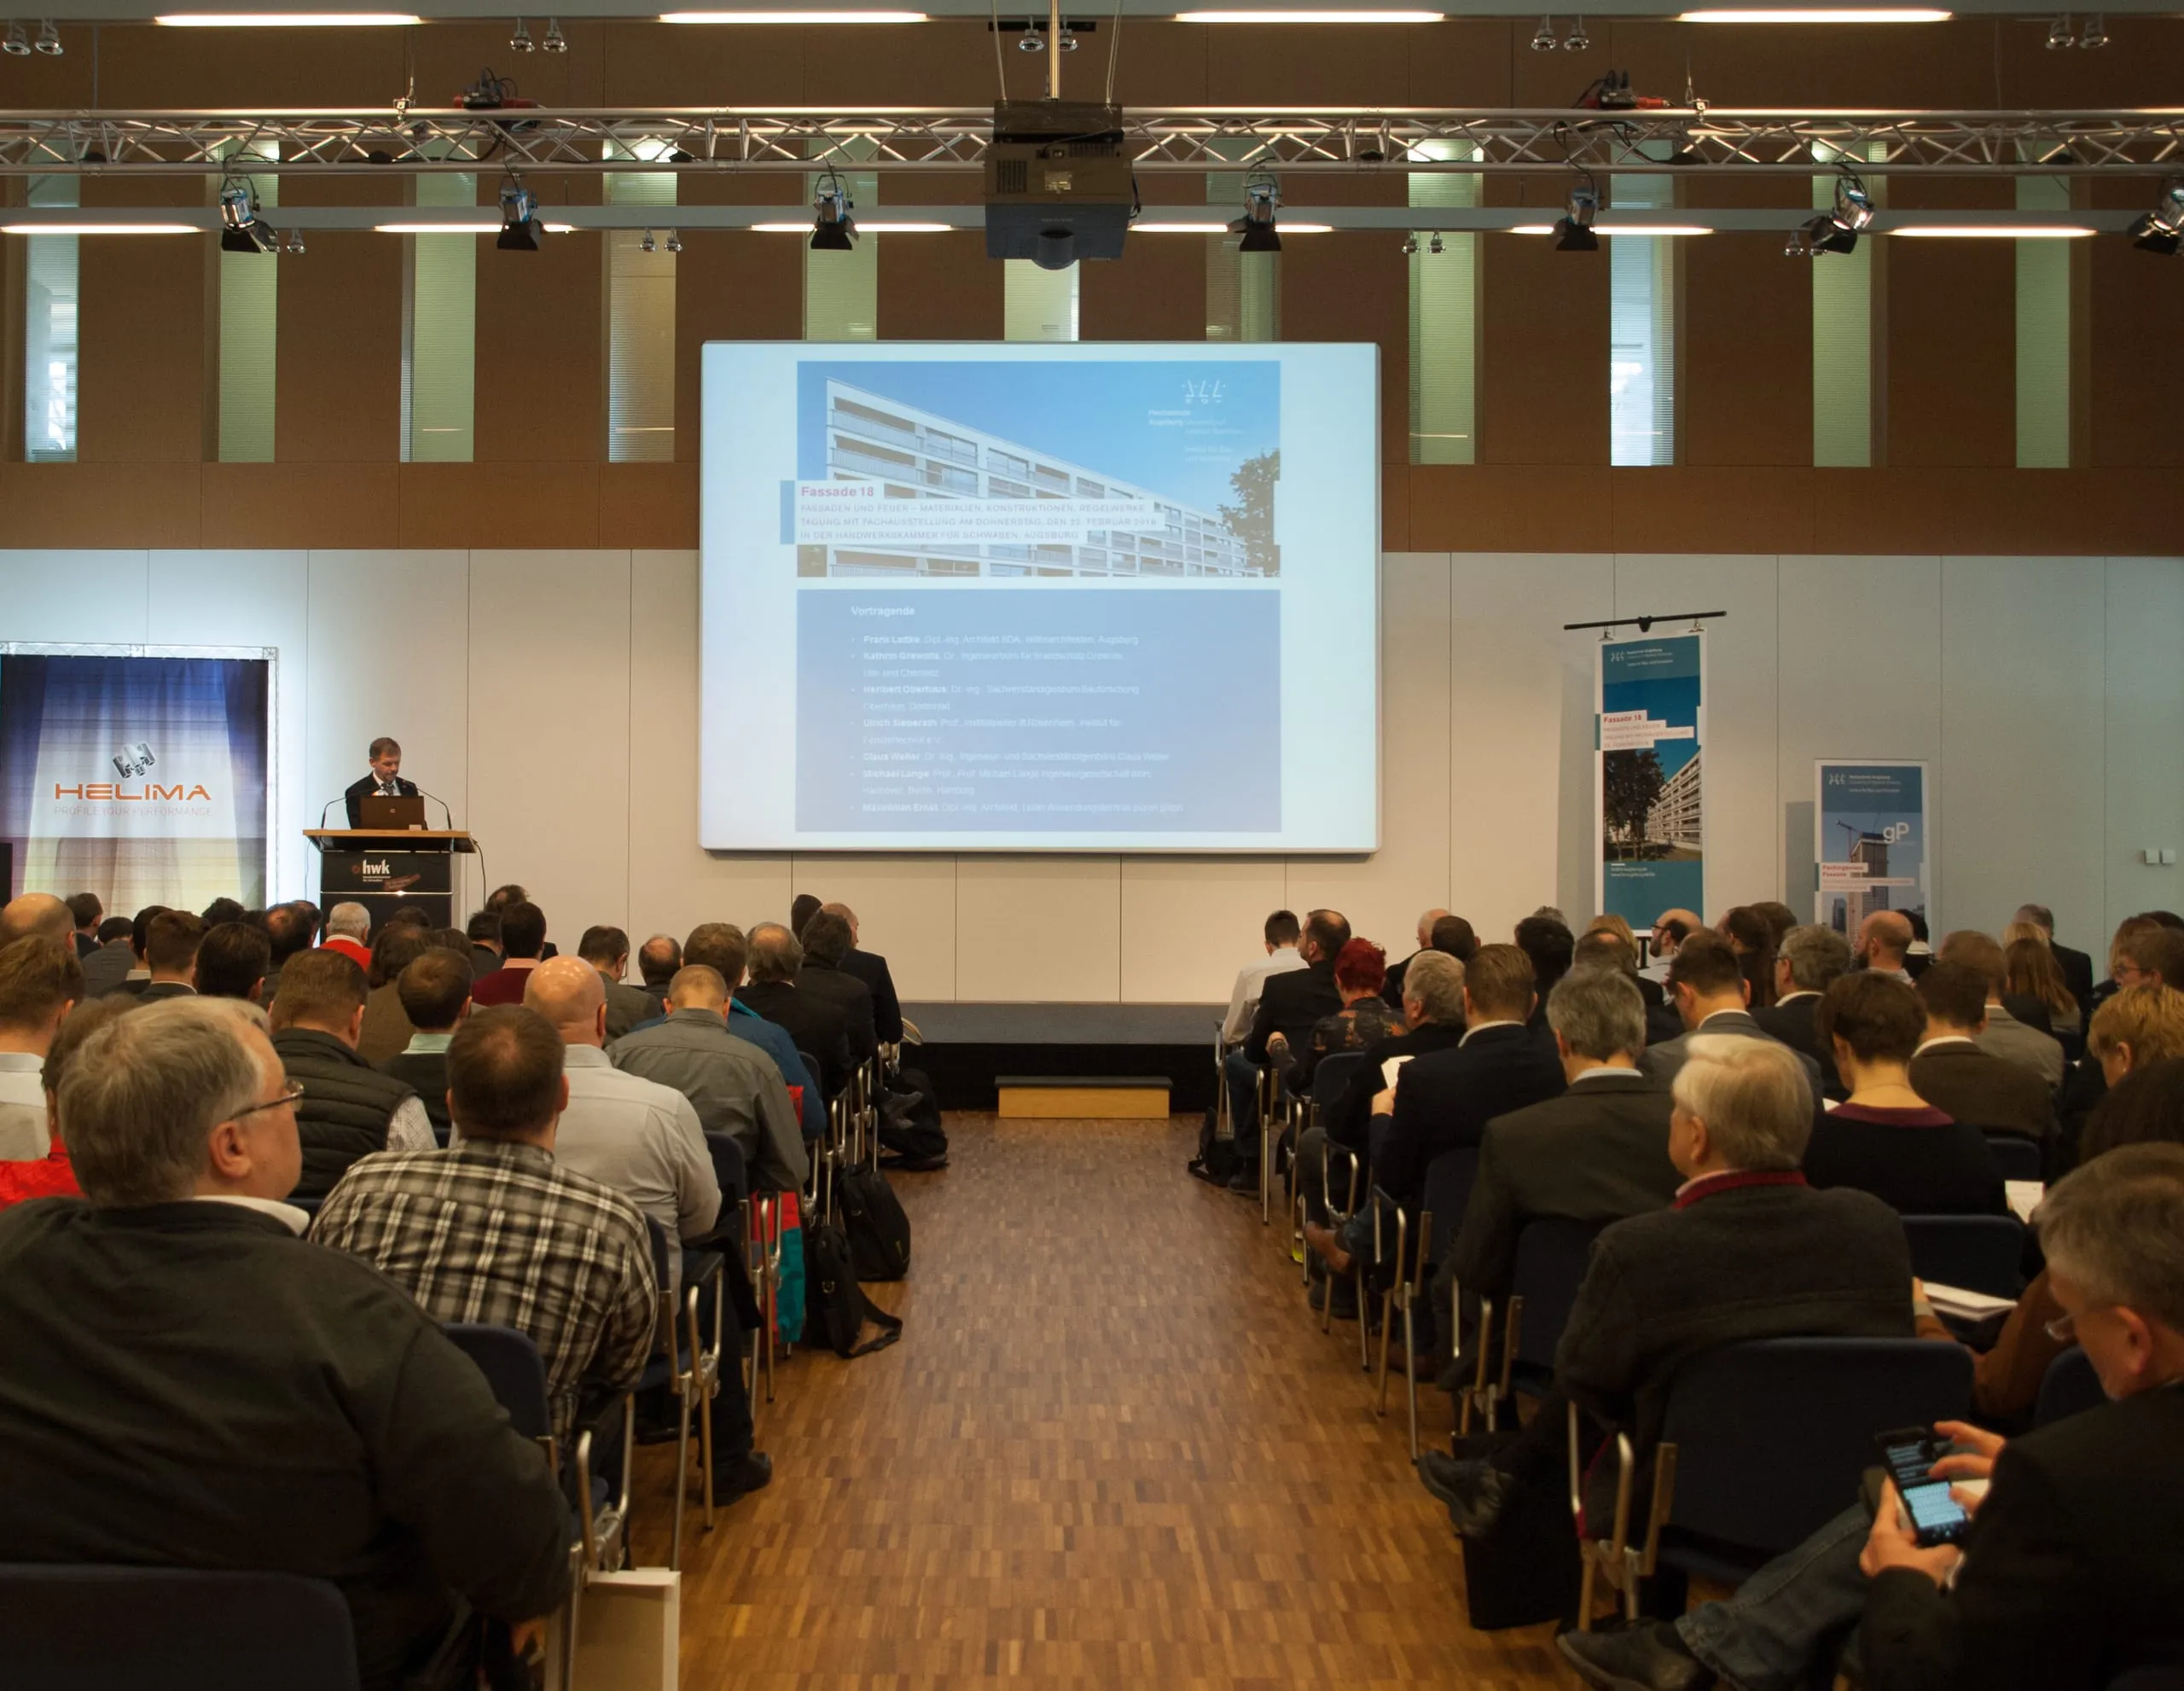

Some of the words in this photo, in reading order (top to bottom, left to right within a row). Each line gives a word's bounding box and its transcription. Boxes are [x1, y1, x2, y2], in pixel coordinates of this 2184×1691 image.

[801, 486, 857, 497] Fassade
[859, 486, 874, 497] 18
[801, 518, 841, 526] TAGUNG
[844, 518, 859, 526] MIT
[863, 518, 956, 526] FACHAUSSTELLUNG
[959, 518, 973, 526] AM
[1047, 518, 1067, 526] DEN
[1087, 518, 1130, 526] FEBRUAR
[801, 531, 810, 540] IN
[813, 531, 833, 540] DER
[836, 531, 938, 540] HANDWERKSKAMMER
[1024, 531, 1078, 540] AUGSBURG
[851, 606, 915, 617] Vortragende
[55, 783, 212, 800] HELIMA
[55, 806, 101, 816] PROFILE
[102, 806, 130, 816] YOUR
[132, 806, 212, 816] PERFORMANCE
[1883, 822, 1909, 844] gP
[363, 859, 391, 875] hwk
